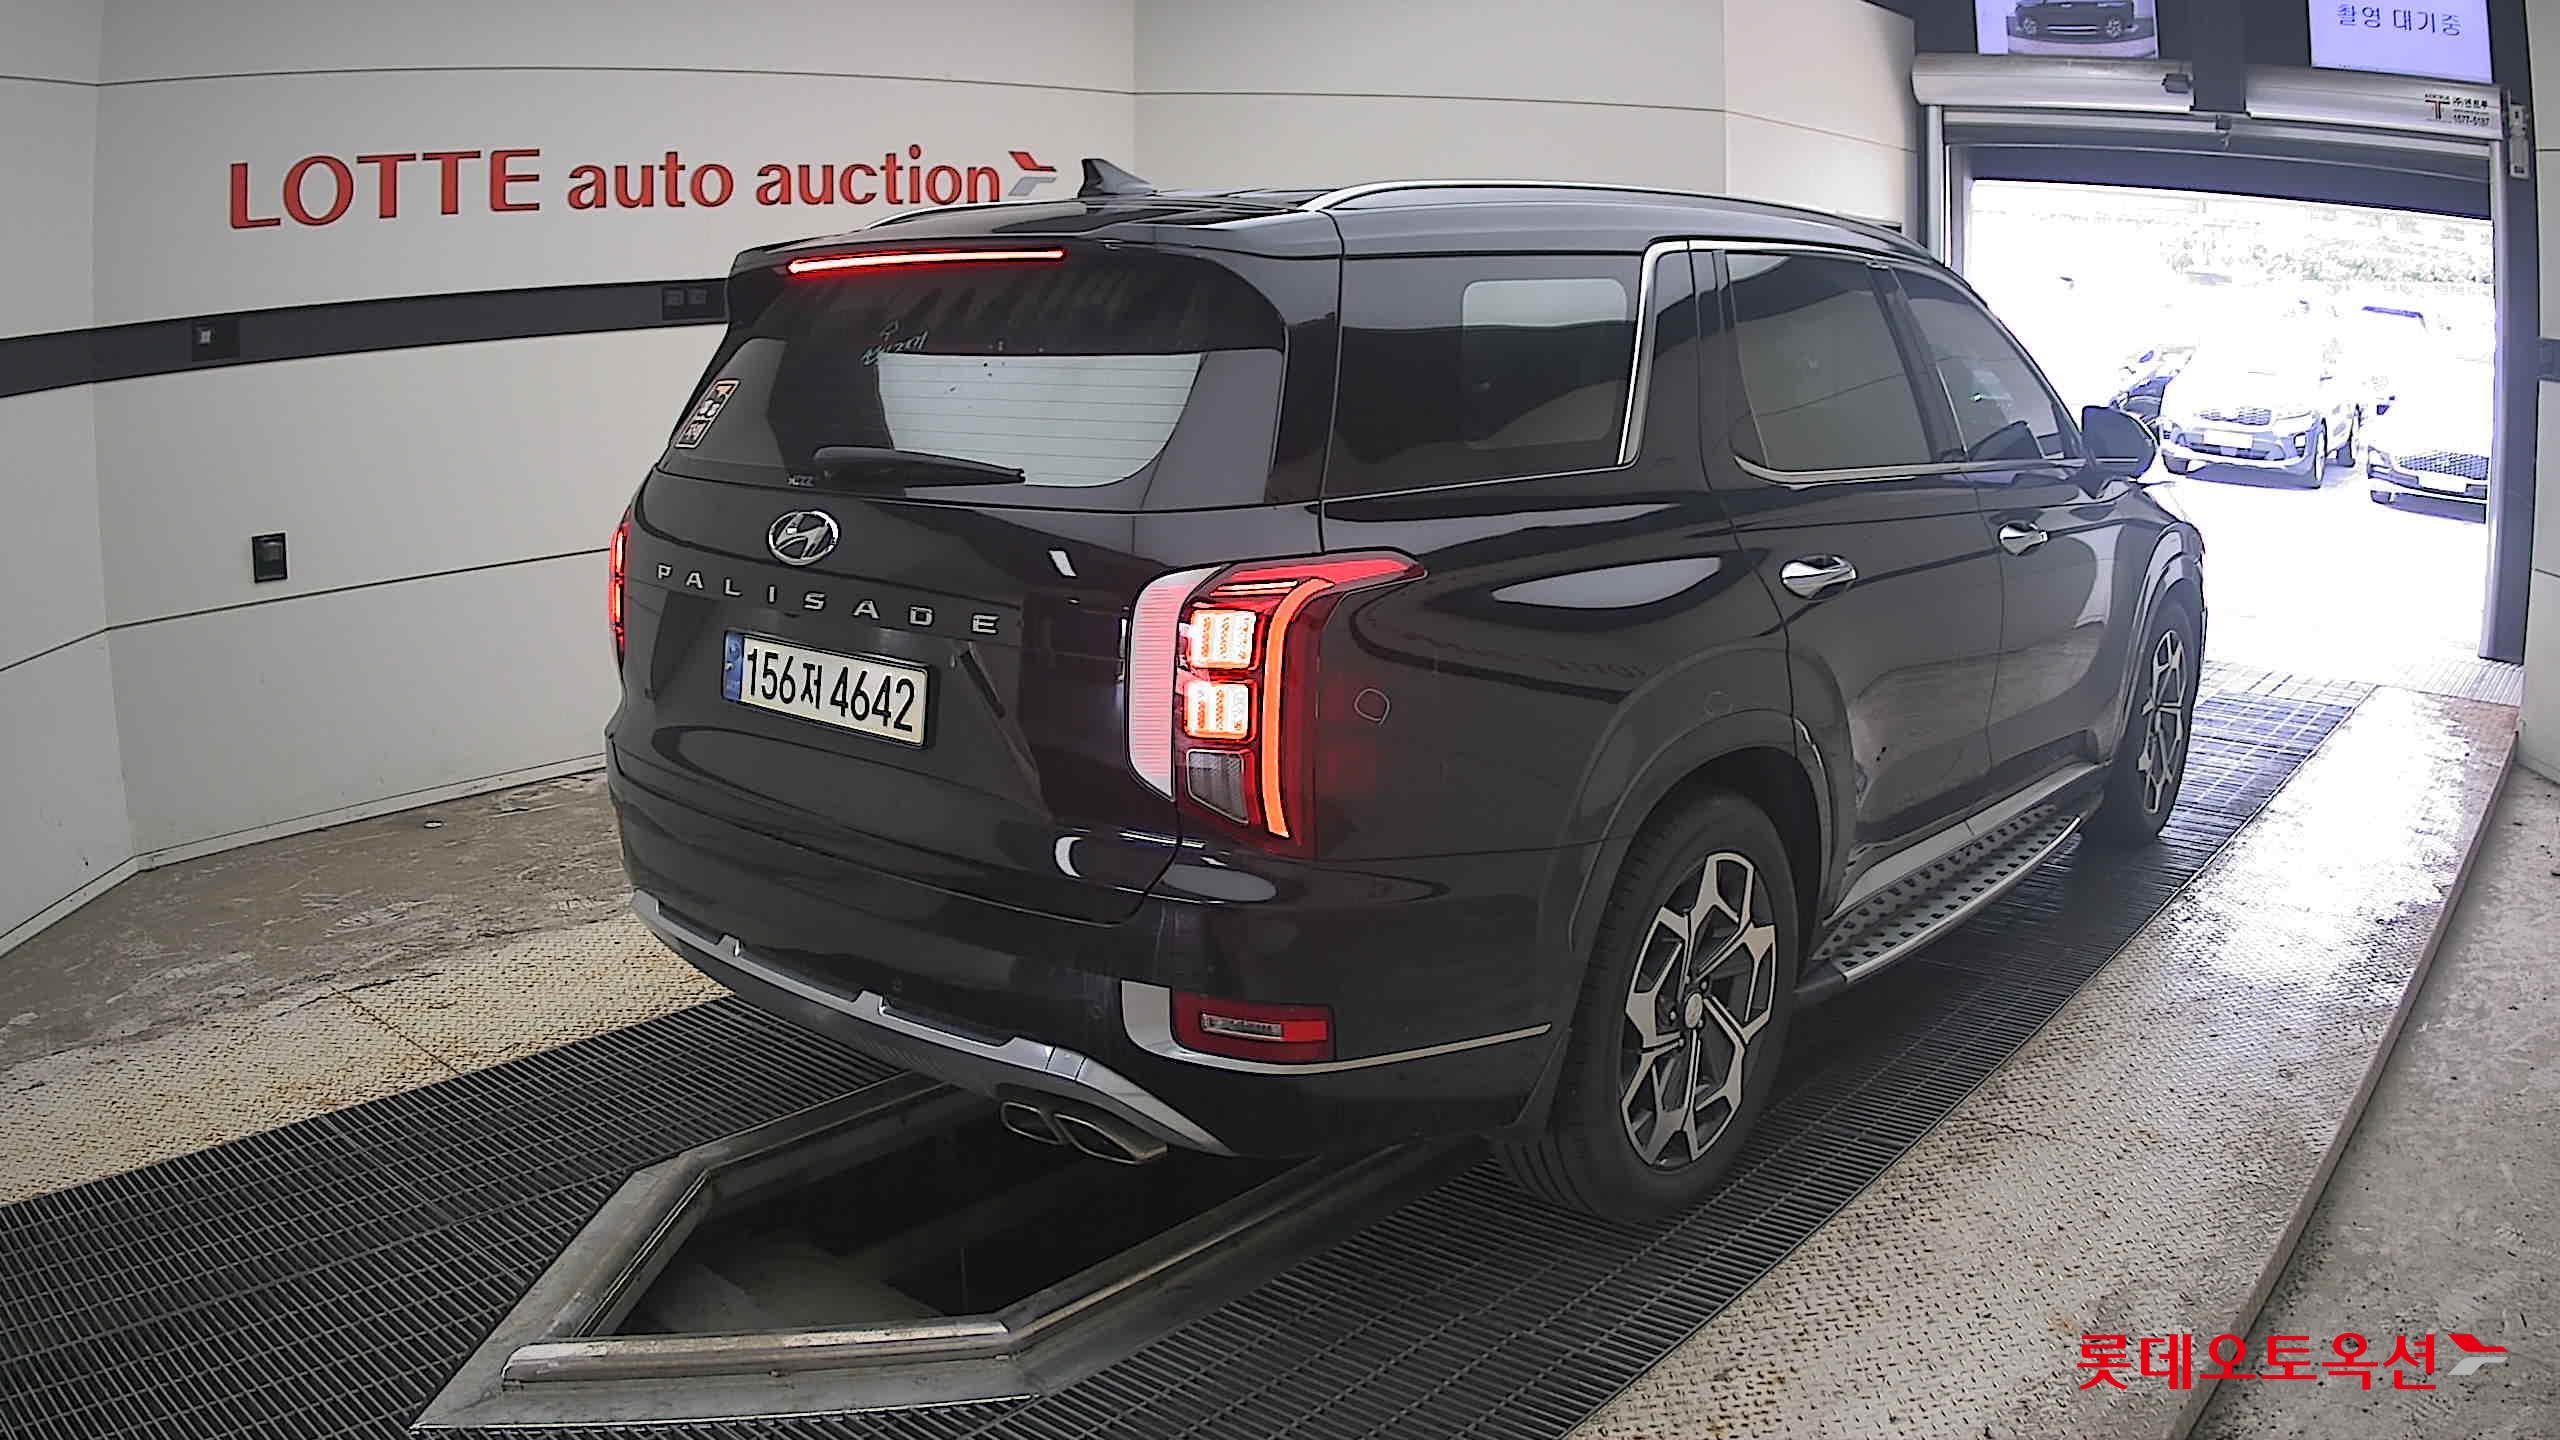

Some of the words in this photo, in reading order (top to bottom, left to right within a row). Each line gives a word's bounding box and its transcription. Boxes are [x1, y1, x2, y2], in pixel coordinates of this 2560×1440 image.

[2392, 8, 2461, 36] 대기중
[229, 148, 541, 230] LOTTE
[566, 151, 735, 210] auto
[755, 144, 1001, 206] auction
[656, 563, 1000, 634] PALISADE
[747, 648, 823, 710] 156저
[829, 666, 915, 733] 4642
